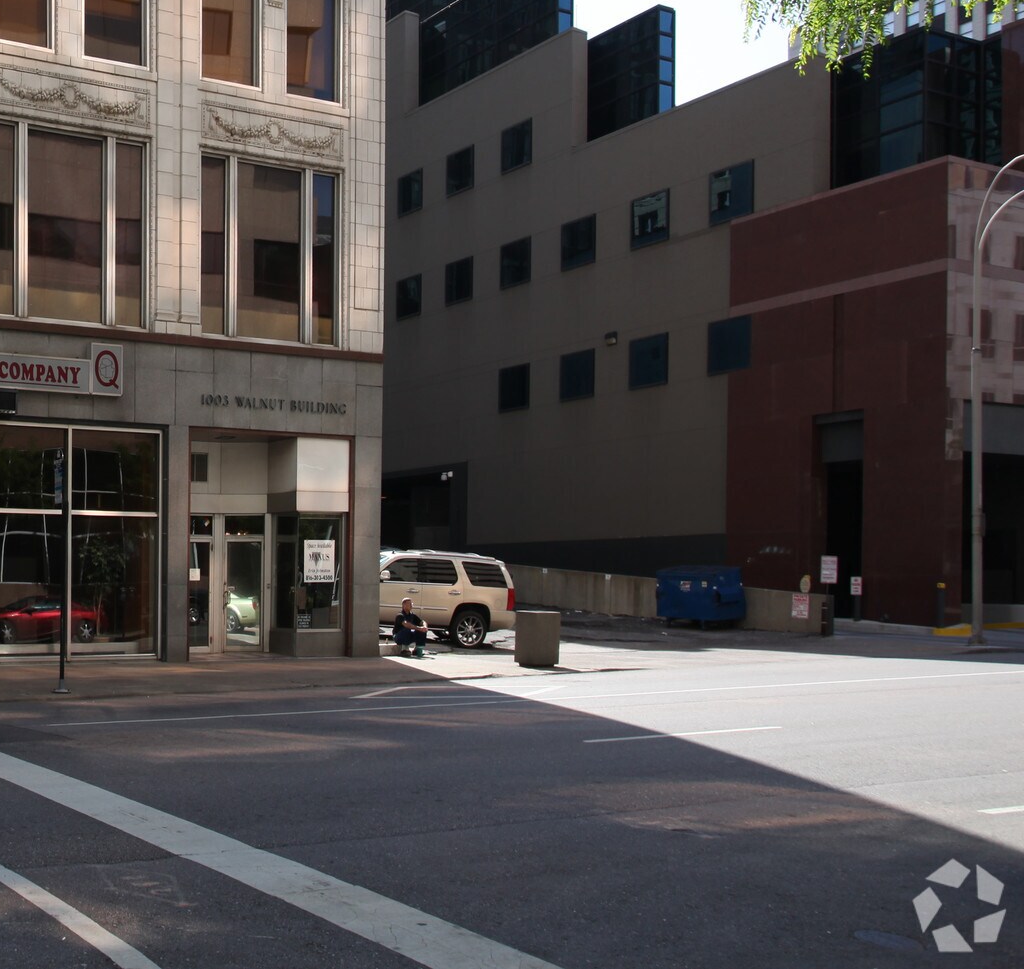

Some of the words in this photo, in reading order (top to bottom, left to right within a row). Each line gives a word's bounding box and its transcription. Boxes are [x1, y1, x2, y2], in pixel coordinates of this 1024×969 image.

[94, 349, 119, 390] Q
[234, 395, 285, 411] WALNUT
[289, 399, 347, 415] BUILDING
